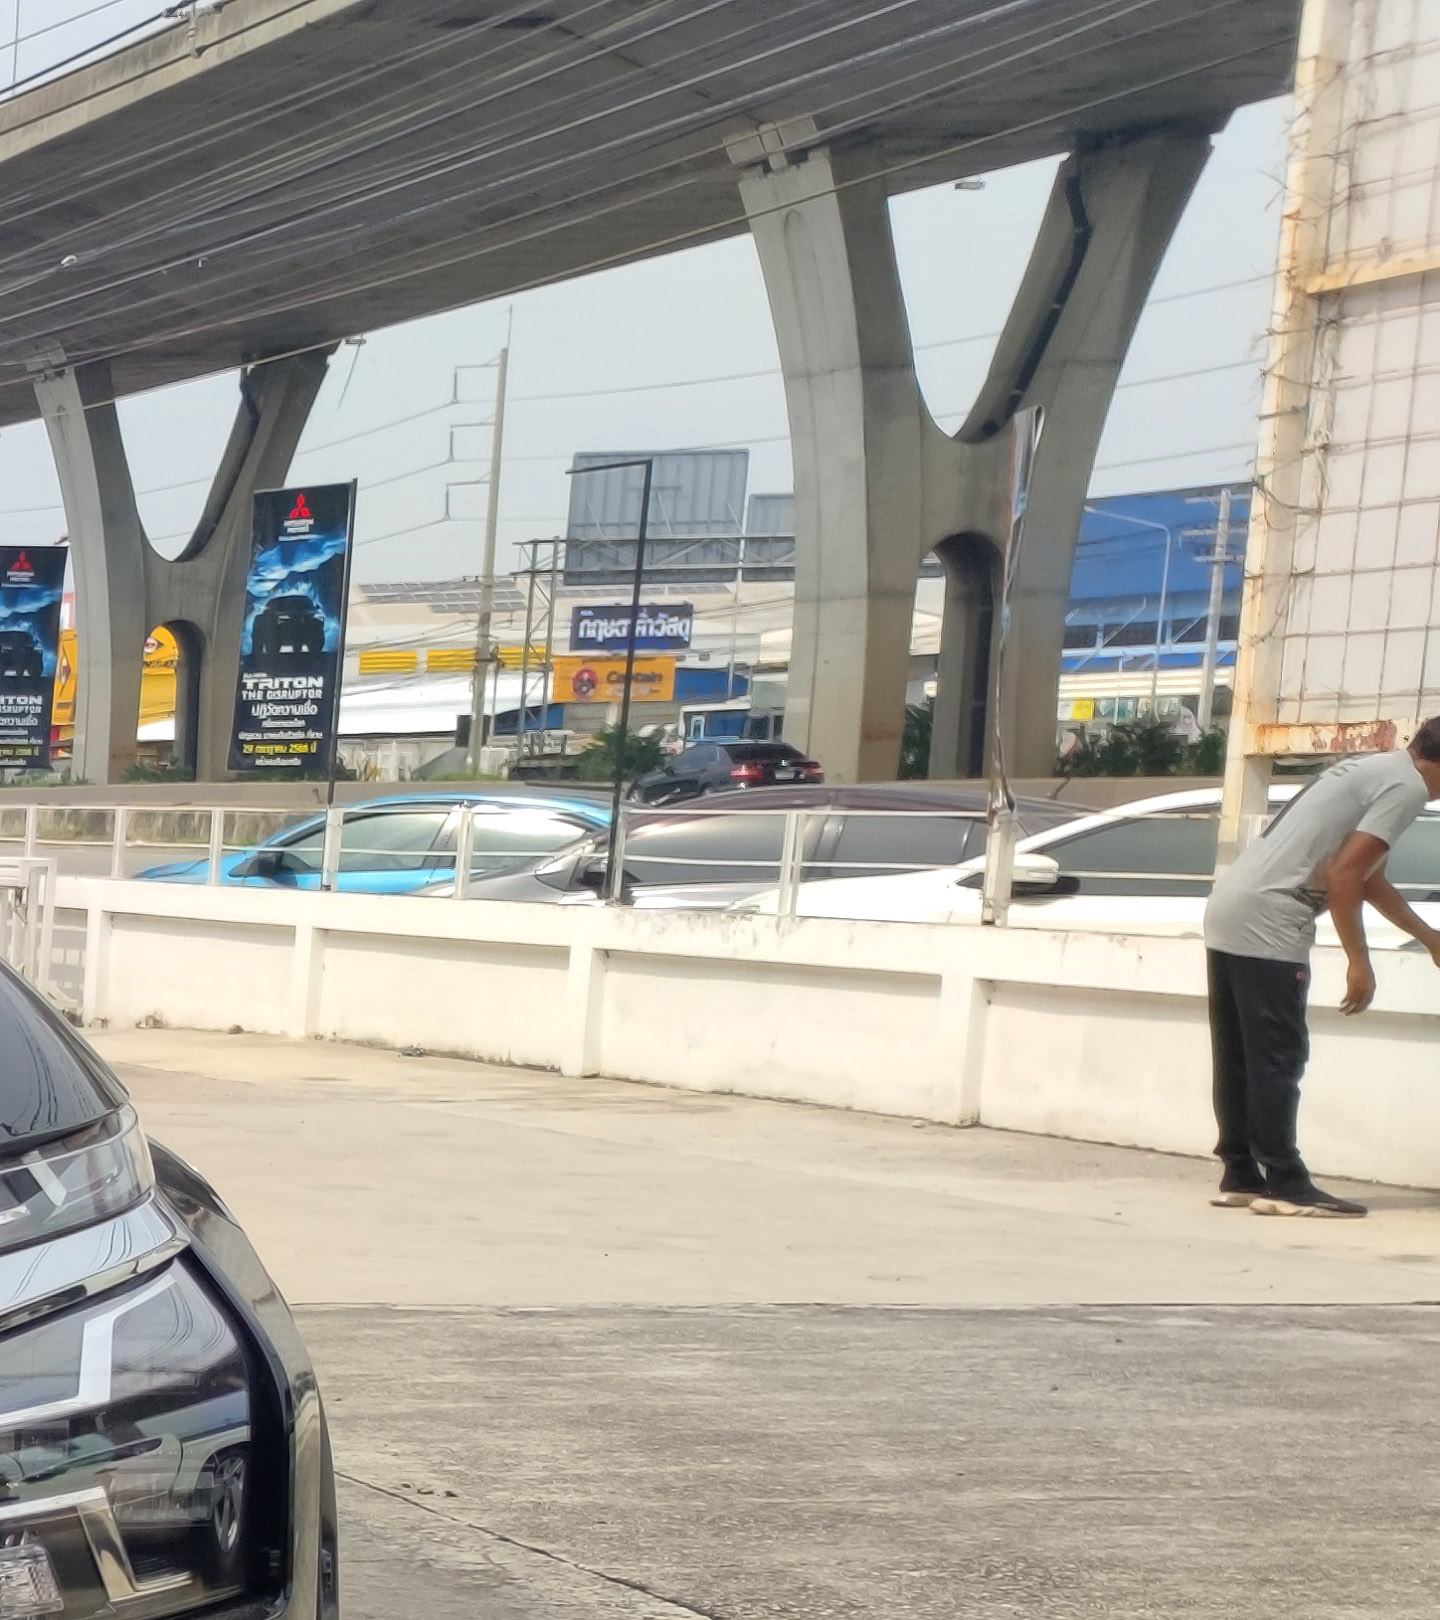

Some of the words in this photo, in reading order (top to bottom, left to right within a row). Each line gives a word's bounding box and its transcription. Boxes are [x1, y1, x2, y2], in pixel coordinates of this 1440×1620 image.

[242, 676, 324, 690] TRITON
[242, 690, 264, 701] THE
[266, 689, 323, 700] DISRUPTOR
